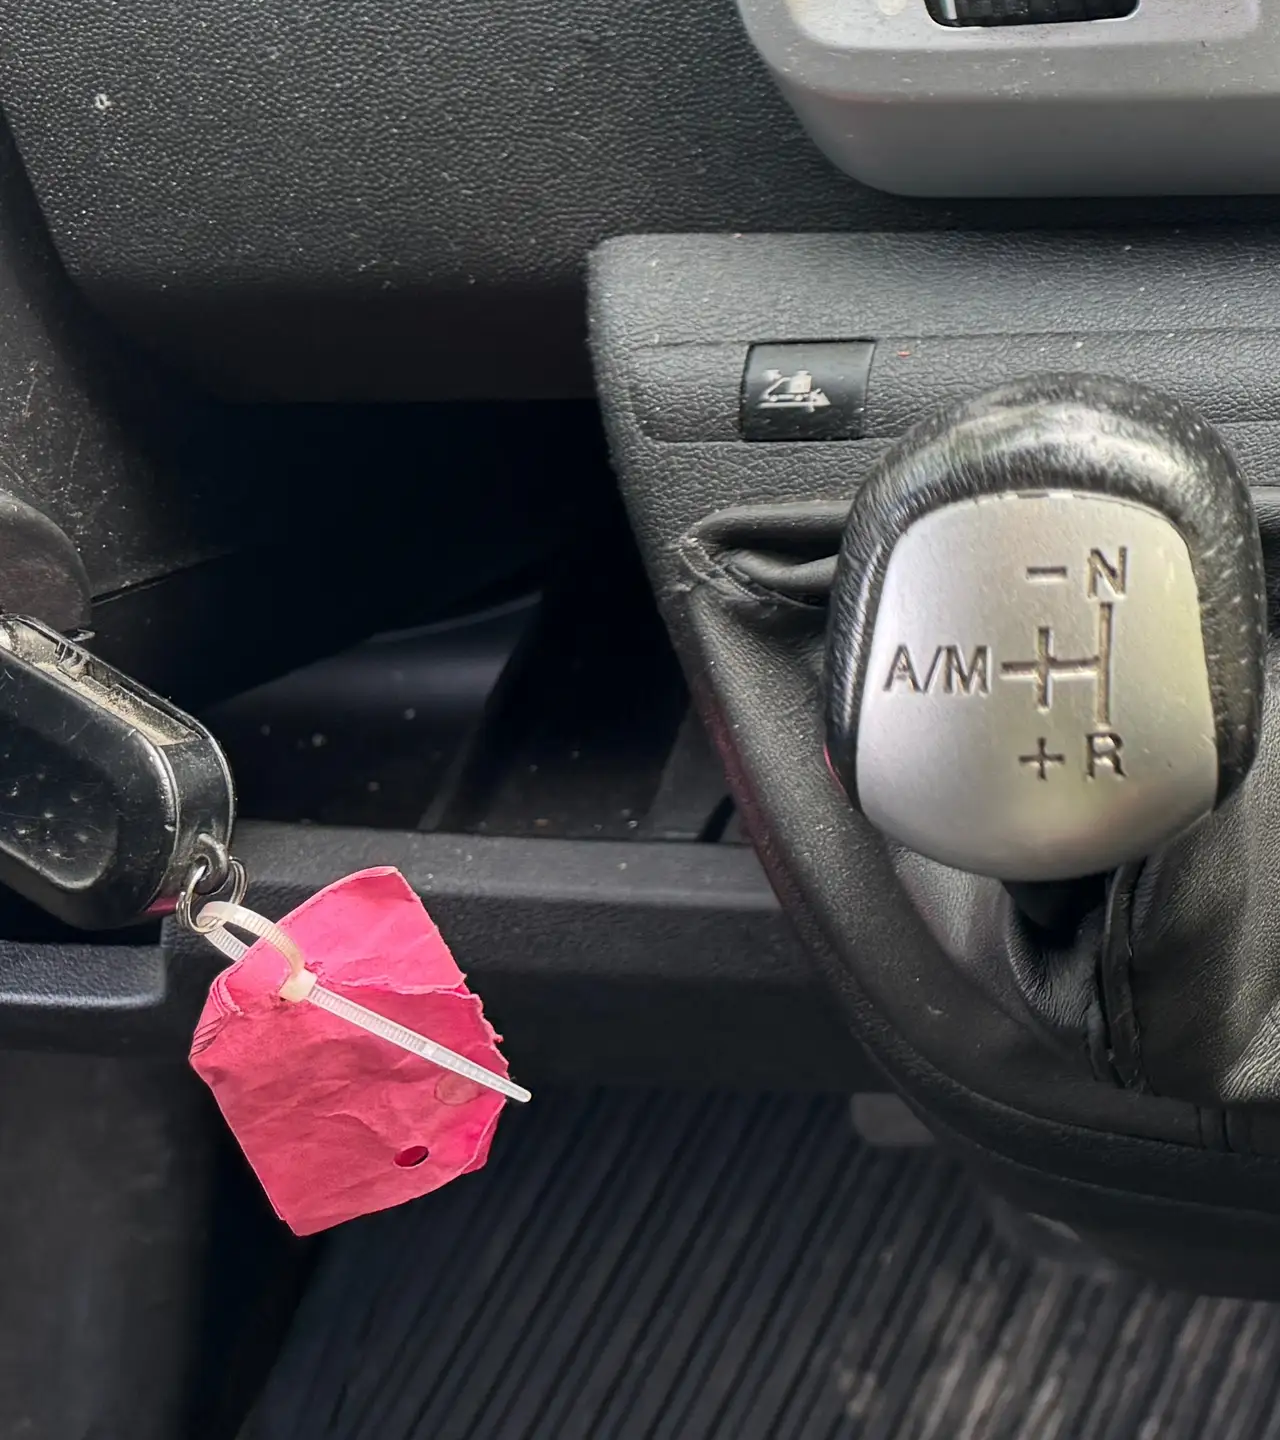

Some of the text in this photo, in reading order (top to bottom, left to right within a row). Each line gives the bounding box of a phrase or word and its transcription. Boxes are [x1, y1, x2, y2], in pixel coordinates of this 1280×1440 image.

[1086, 545, 1128, 601] N
[883, 643, 993, 698] A/M
[1084, 730, 1128, 783] R
